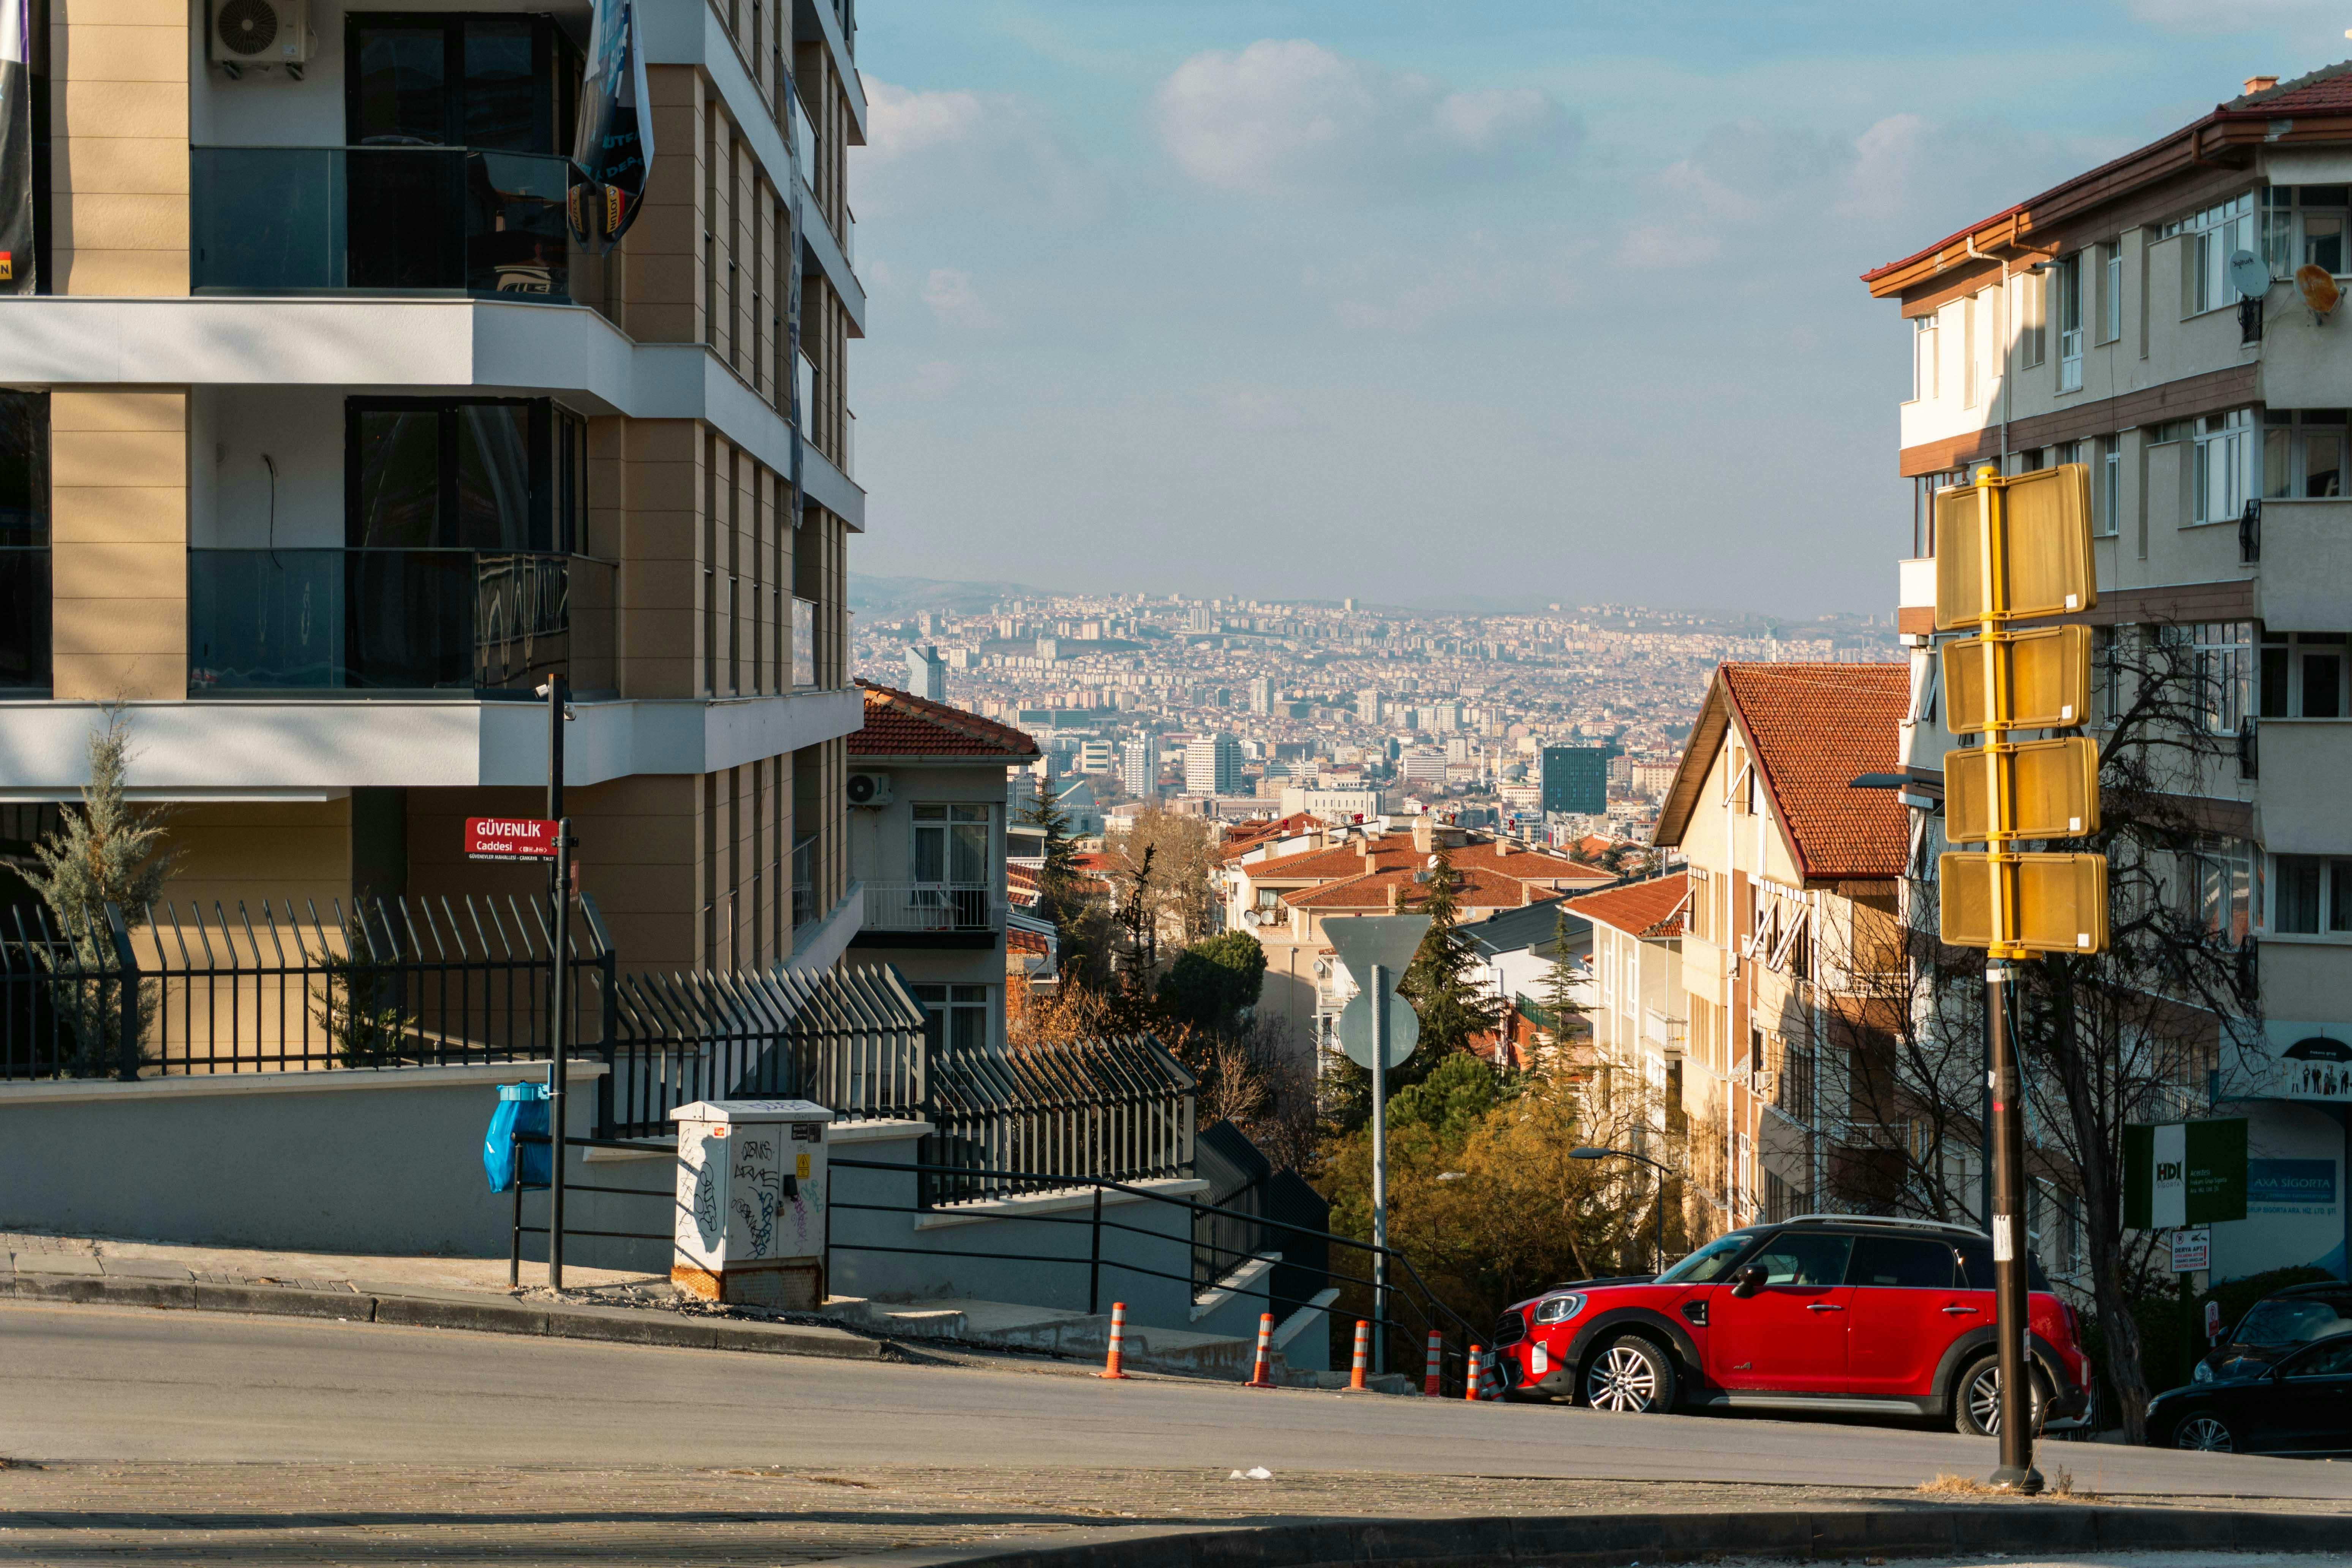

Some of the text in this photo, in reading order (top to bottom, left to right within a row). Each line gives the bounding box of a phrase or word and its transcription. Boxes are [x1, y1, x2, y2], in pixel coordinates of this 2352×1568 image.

[477, 819, 541, 837] GÜVENLİK
[476, 841, 512, 851] Caddesi
[2156, 1161, 2181, 1181] HDI
[2190, 1168, 2210, 1176] Acentesi
[2254, 1176, 2330, 1188] AXA SİGORTA
